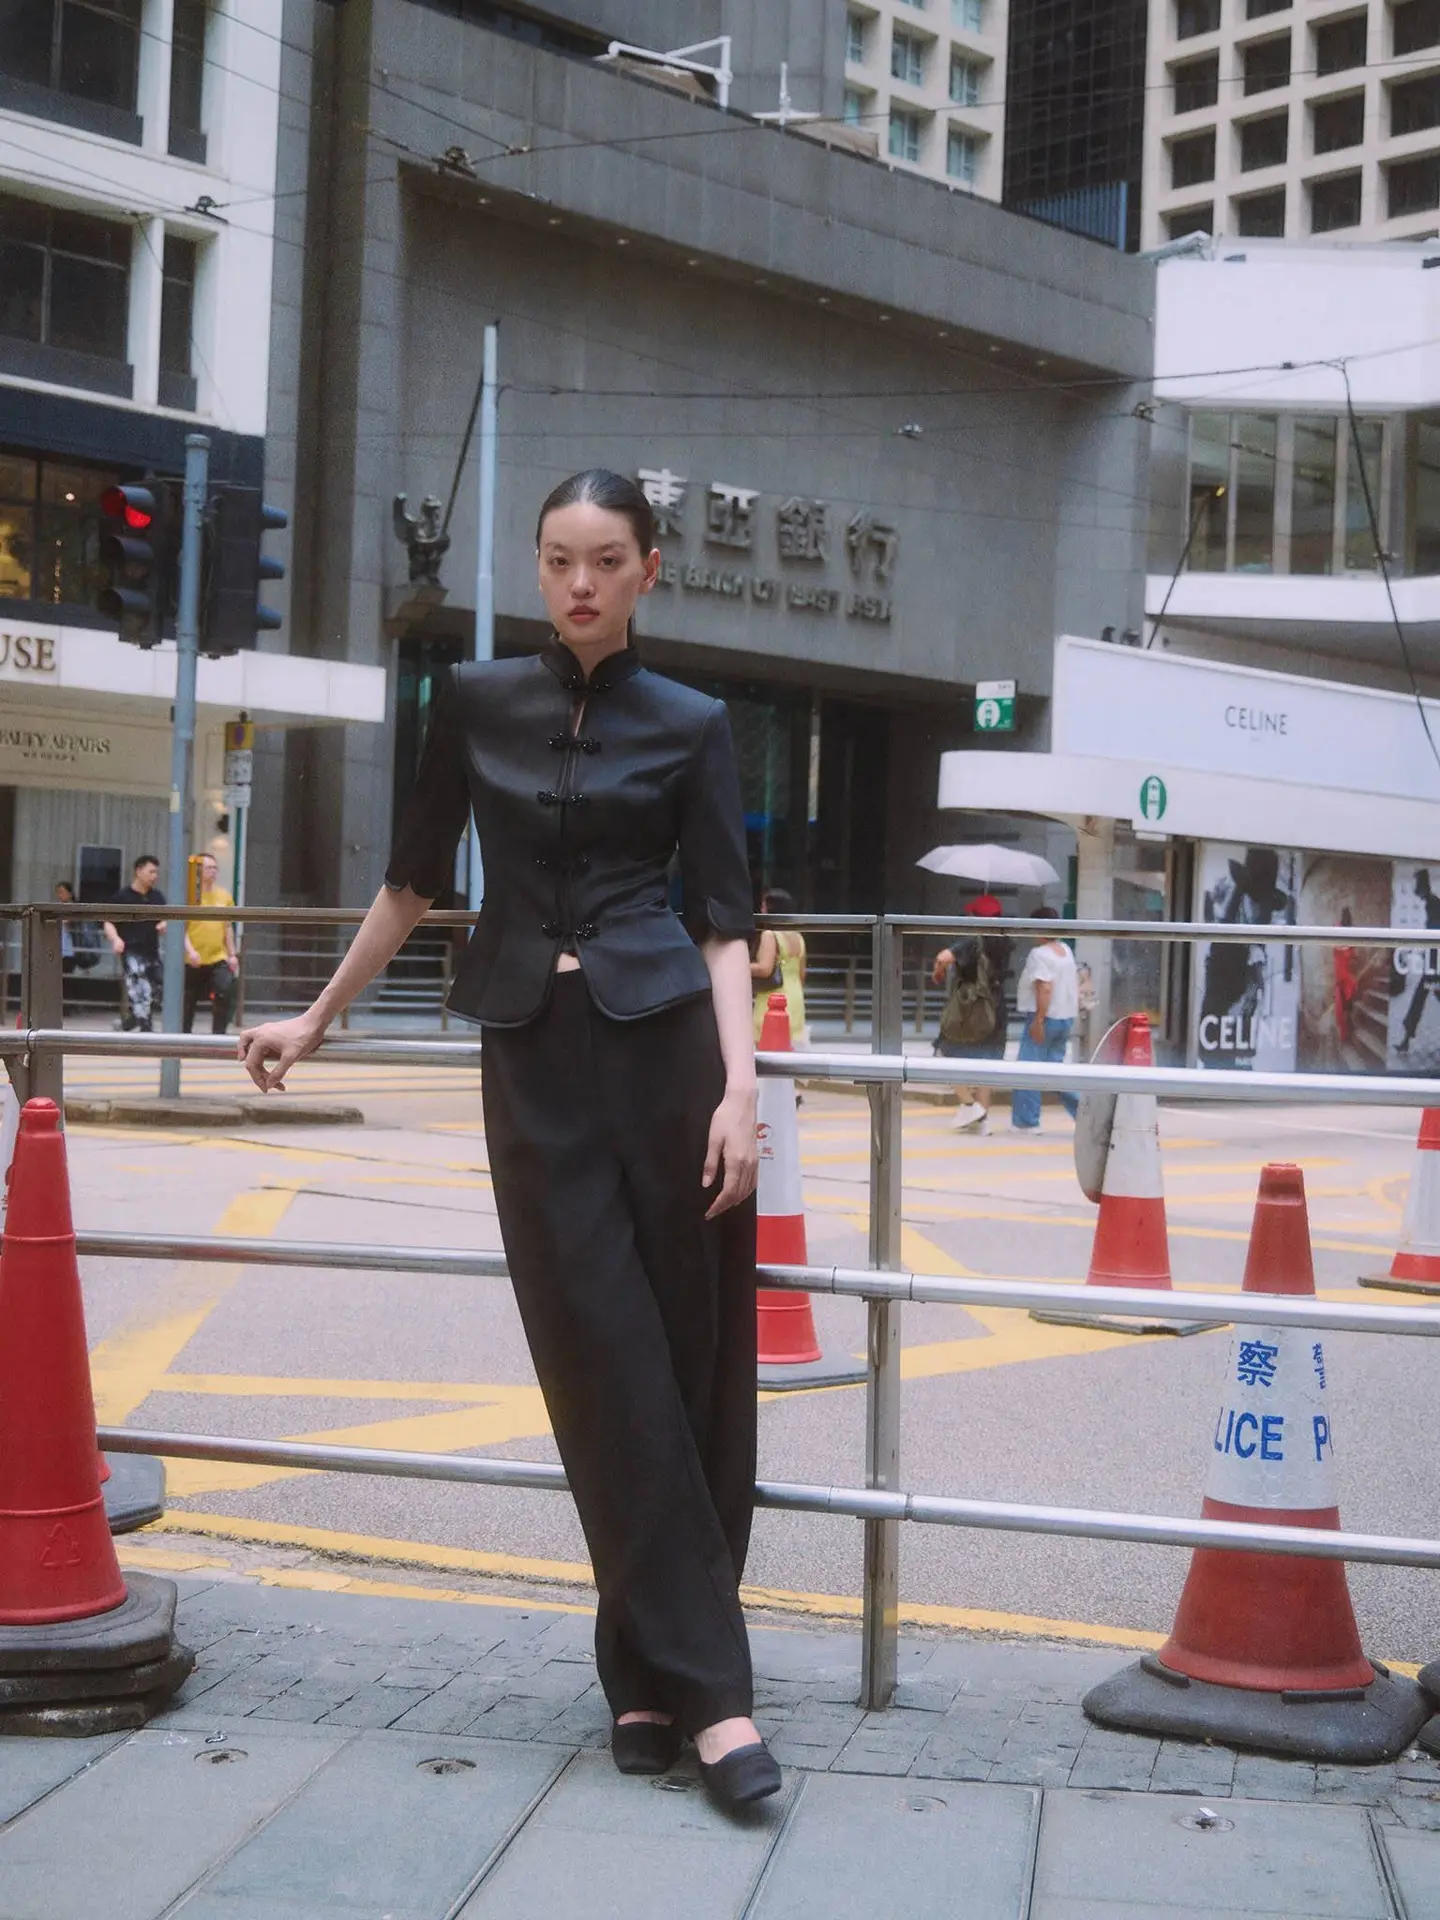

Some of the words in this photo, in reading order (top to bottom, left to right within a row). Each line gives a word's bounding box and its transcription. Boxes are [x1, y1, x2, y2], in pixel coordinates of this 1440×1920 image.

[1224, 704, 1288, 736] CELINE
[1200, 1014, 1293, 1050] CELINE
[1237, 1339, 1279, 1388] 察
[1312, 1414, 1334, 1462] P
